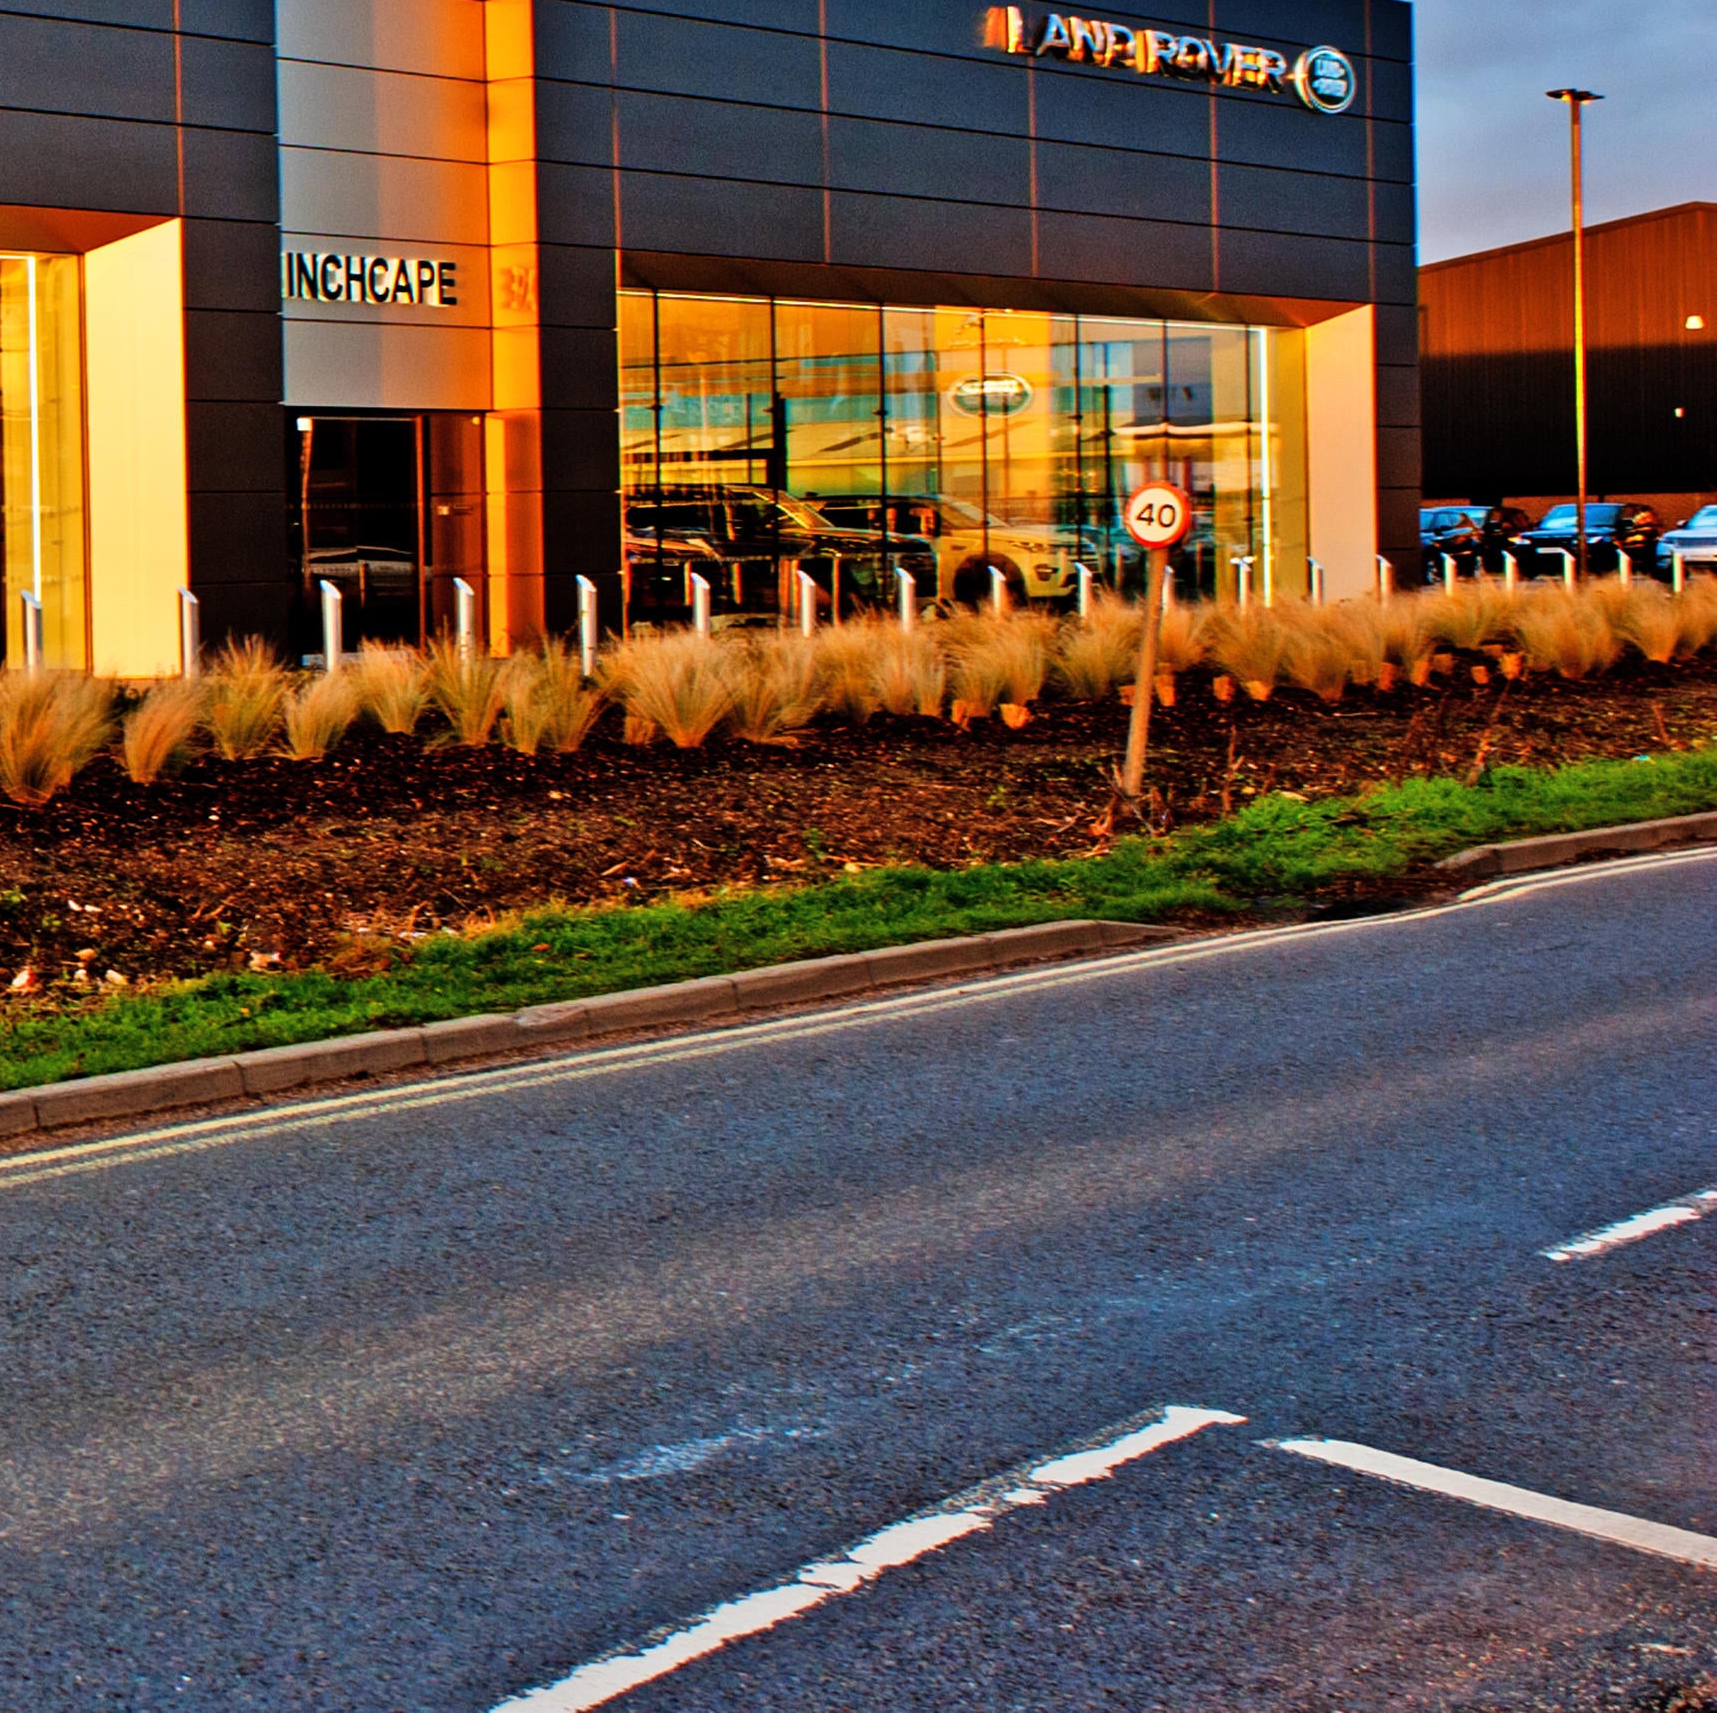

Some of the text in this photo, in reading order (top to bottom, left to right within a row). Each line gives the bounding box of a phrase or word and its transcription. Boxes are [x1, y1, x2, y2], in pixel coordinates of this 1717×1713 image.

[1005, 5, 1287, 93] LAND ROVER
[283, 252, 457, 306] INCHCAPE
[1136, 503, 1176, 528] 40
